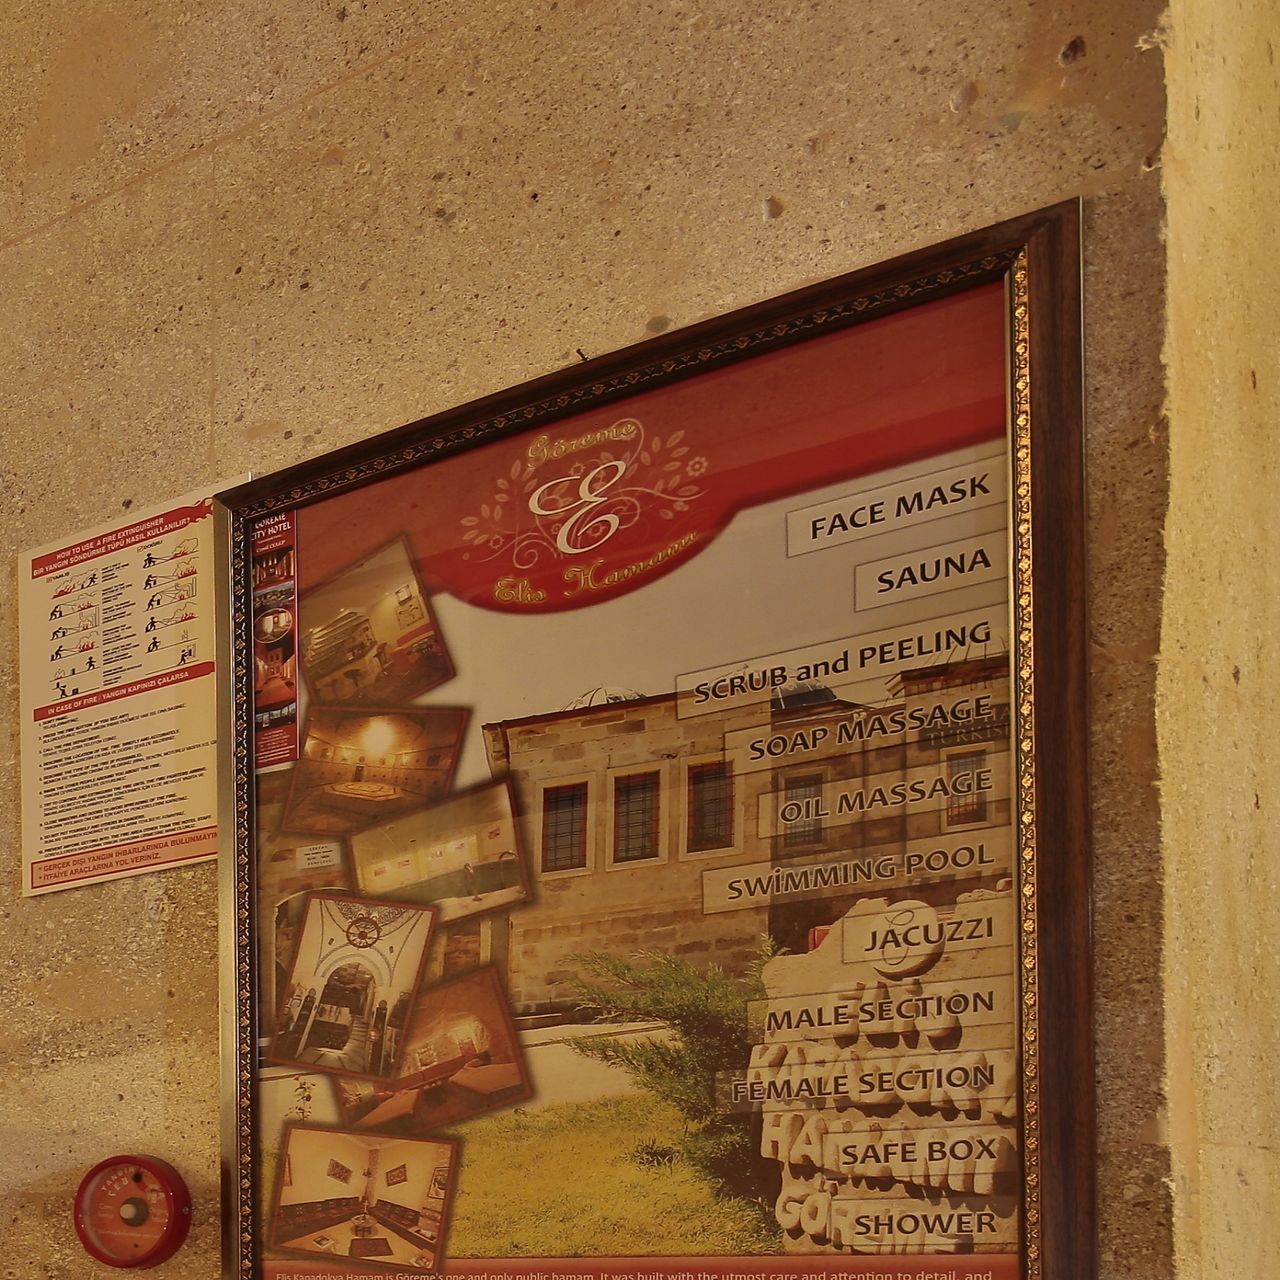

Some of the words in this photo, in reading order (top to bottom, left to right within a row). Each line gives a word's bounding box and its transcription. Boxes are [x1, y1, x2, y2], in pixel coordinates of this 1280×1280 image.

[528, 423, 636, 469] Göreme
[810, 502, 886, 540] FACE
[896, 473, 990, 518] MASK
[56, 551, 71, 560] HOW
[82, 544, 94, 552] USE
[102, 534, 116, 544] FIRE
[118, 518, 164, 539] EXTINGUISHER
[45, 560, 68, 572] YANGIN
[877, 548, 992, 593] SAUNA
[694, 666, 787, 704] SCRUB
[796, 651, 849, 682] and
[859, 622, 991, 668] PEELING
[56, 703, 72, 713] CASE
[83, 697, 97, 706] FIRE
[157, 671, 189, 686] ÇALARSA
[750, 728, 828, 760] SOAP
[837, 694, 992, 744] MASSAGE
[780, 798, 829, 823] OIL
[838, 769, 992, 814] MASSAGE
[44, 861, 70, 873] GERÇEK
[87, 854, 113, 864] YANGIN
[70, 862, 113, 877] ARAÇLARINA
[115, 859, 129, 867] YOL
[728, 858, 895, 900] SWİMMING
[906, 844, 994, 874] POOL
[864, 917, 993, 952] JACUZZI
[767, 1004, 850, 1032] MALE
[859, 990, 994, 1022] SECTION
[732, 1074, 850, 1102] FEMALE
[859, 1065, 994, 1094] SECTION
[842, 1142, 916, 1165] SAFE
[928, 1138, 998, 1162] BOX
[855, 1213, 998, 1236] SHOWER
